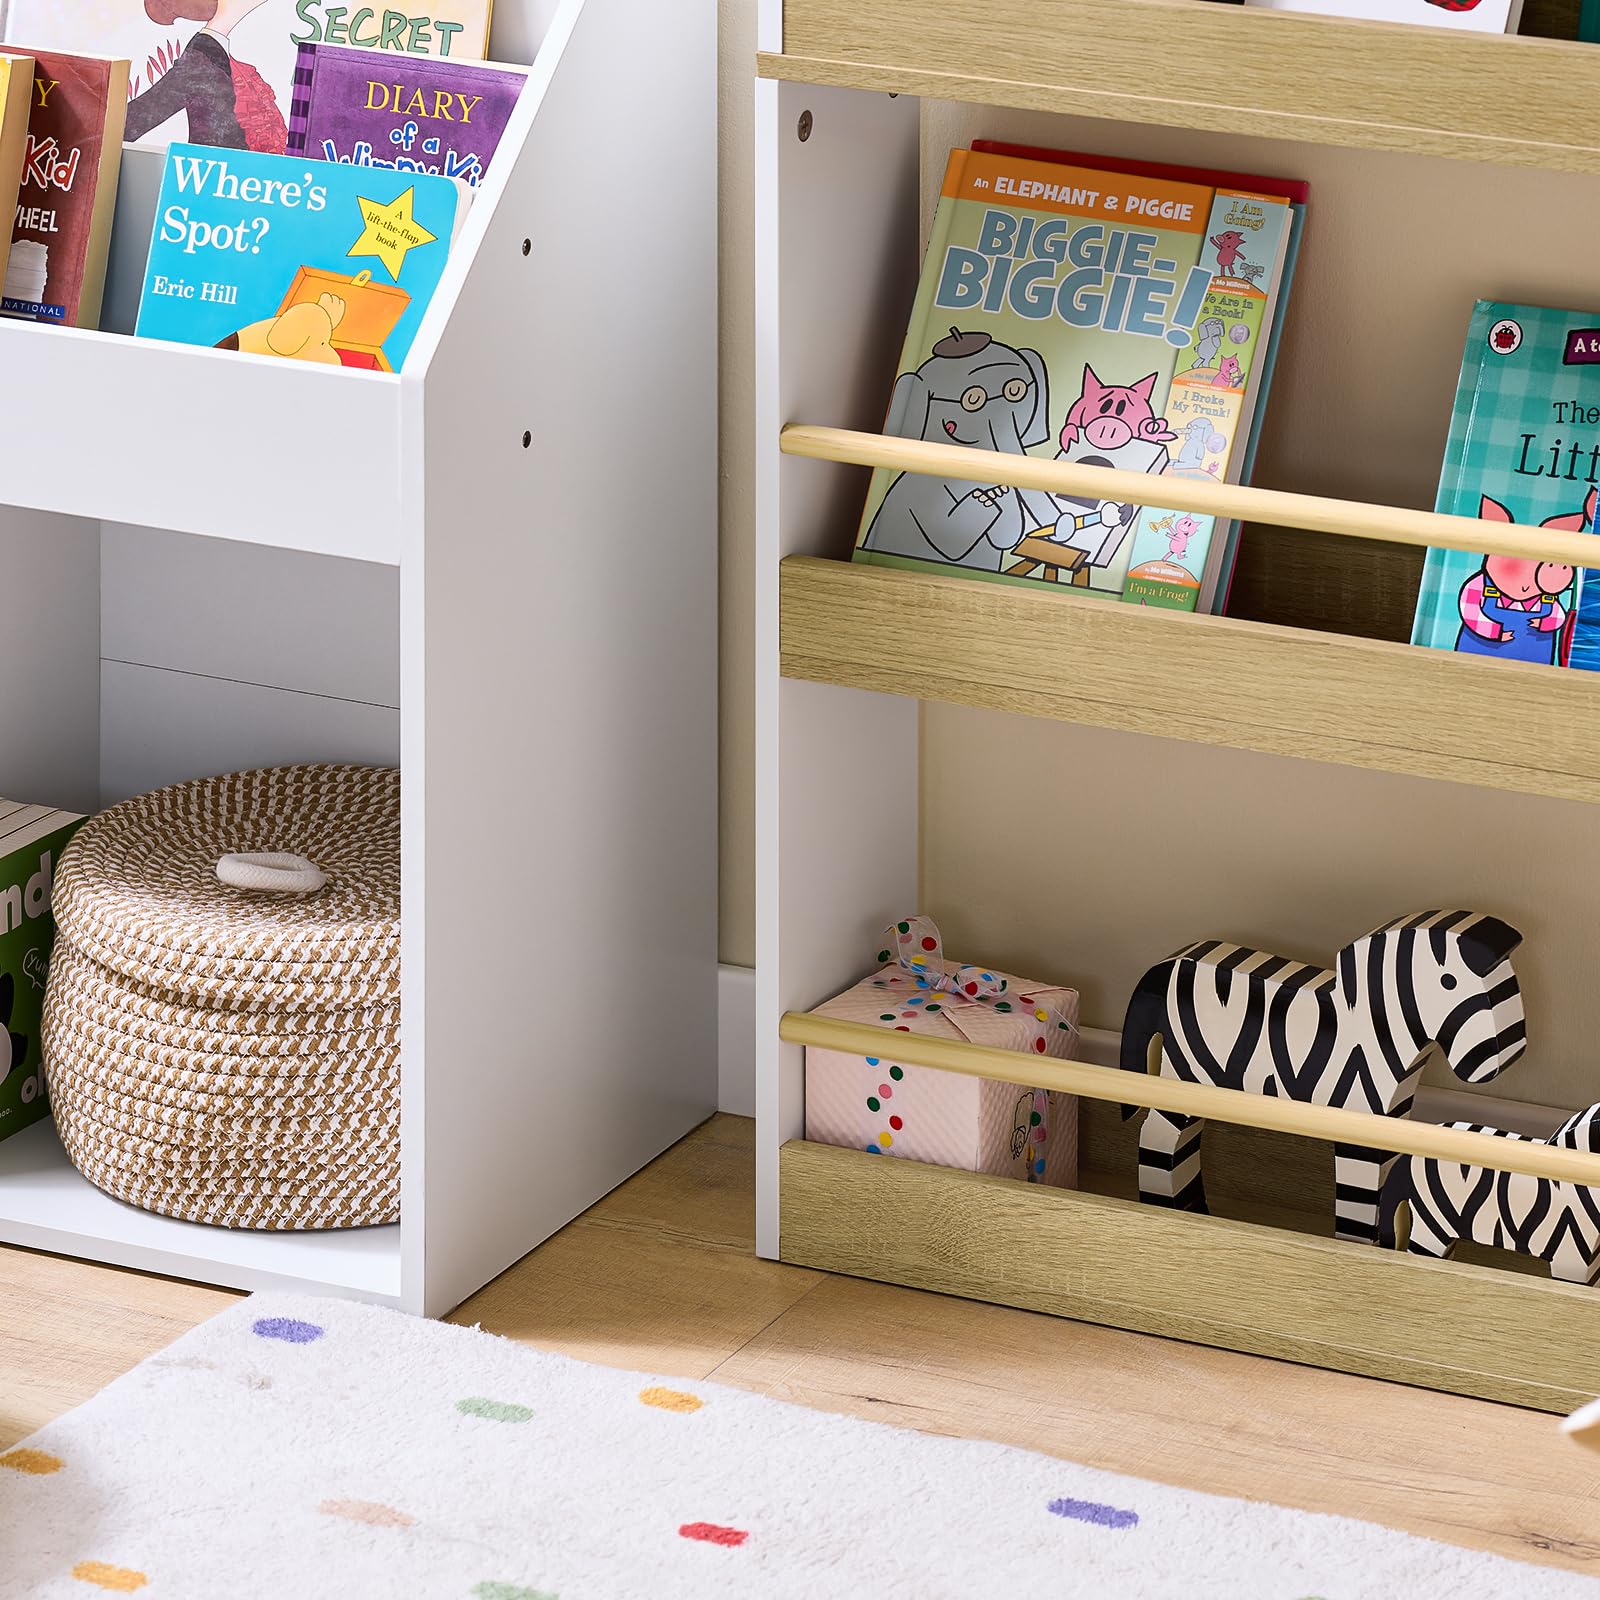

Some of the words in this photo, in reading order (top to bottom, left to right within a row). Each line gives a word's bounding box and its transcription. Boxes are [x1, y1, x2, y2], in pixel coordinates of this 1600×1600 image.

[290, 0, 464, 57] SECRET
[363, 80, 483, 124] DIARY
[389, 121, 418, 151] of
[422, 137, 440, 154] a
[20, 135, 78, 190] Kid
[172, 155, 327, 212] Where's
[973, 177, 989, 190] An
[994, 176, 1100, 209] ELEPHANT
[1104, 195, 1119, 211] &
[1125, 197, 1194, 222] PIGGIE
[1240, 203, 1263, 216] Am
[160, 205, 270, 255] Spot?
[366, 211, 420, 245] lift-the-flap
[395, 210, 403, 221] A
[375, 232, 398, 250] book
[977, 209, 1177, 277] BIGGIE-
[152, 275, 195, 299] Eric
[199, 281, 238, 305] Hill
[933, 245, 1213, 350] BIGGIE!
[1219, 295, 1239, 307] Are
[1242, 298, 1254, 309] in
[1212, 305, 1244, 319] Book!
[1574, 337, 1586, 353] A
[1172, 400, 1189, 413] My
[1193, 403, 1231, 418] Trunk!
[1183, 390, 1190, 400] I
[1191, 391, 1225, 406] Broke
[1552, 400, 1600, 424] The
[1149, 588, 1156, 597] a
